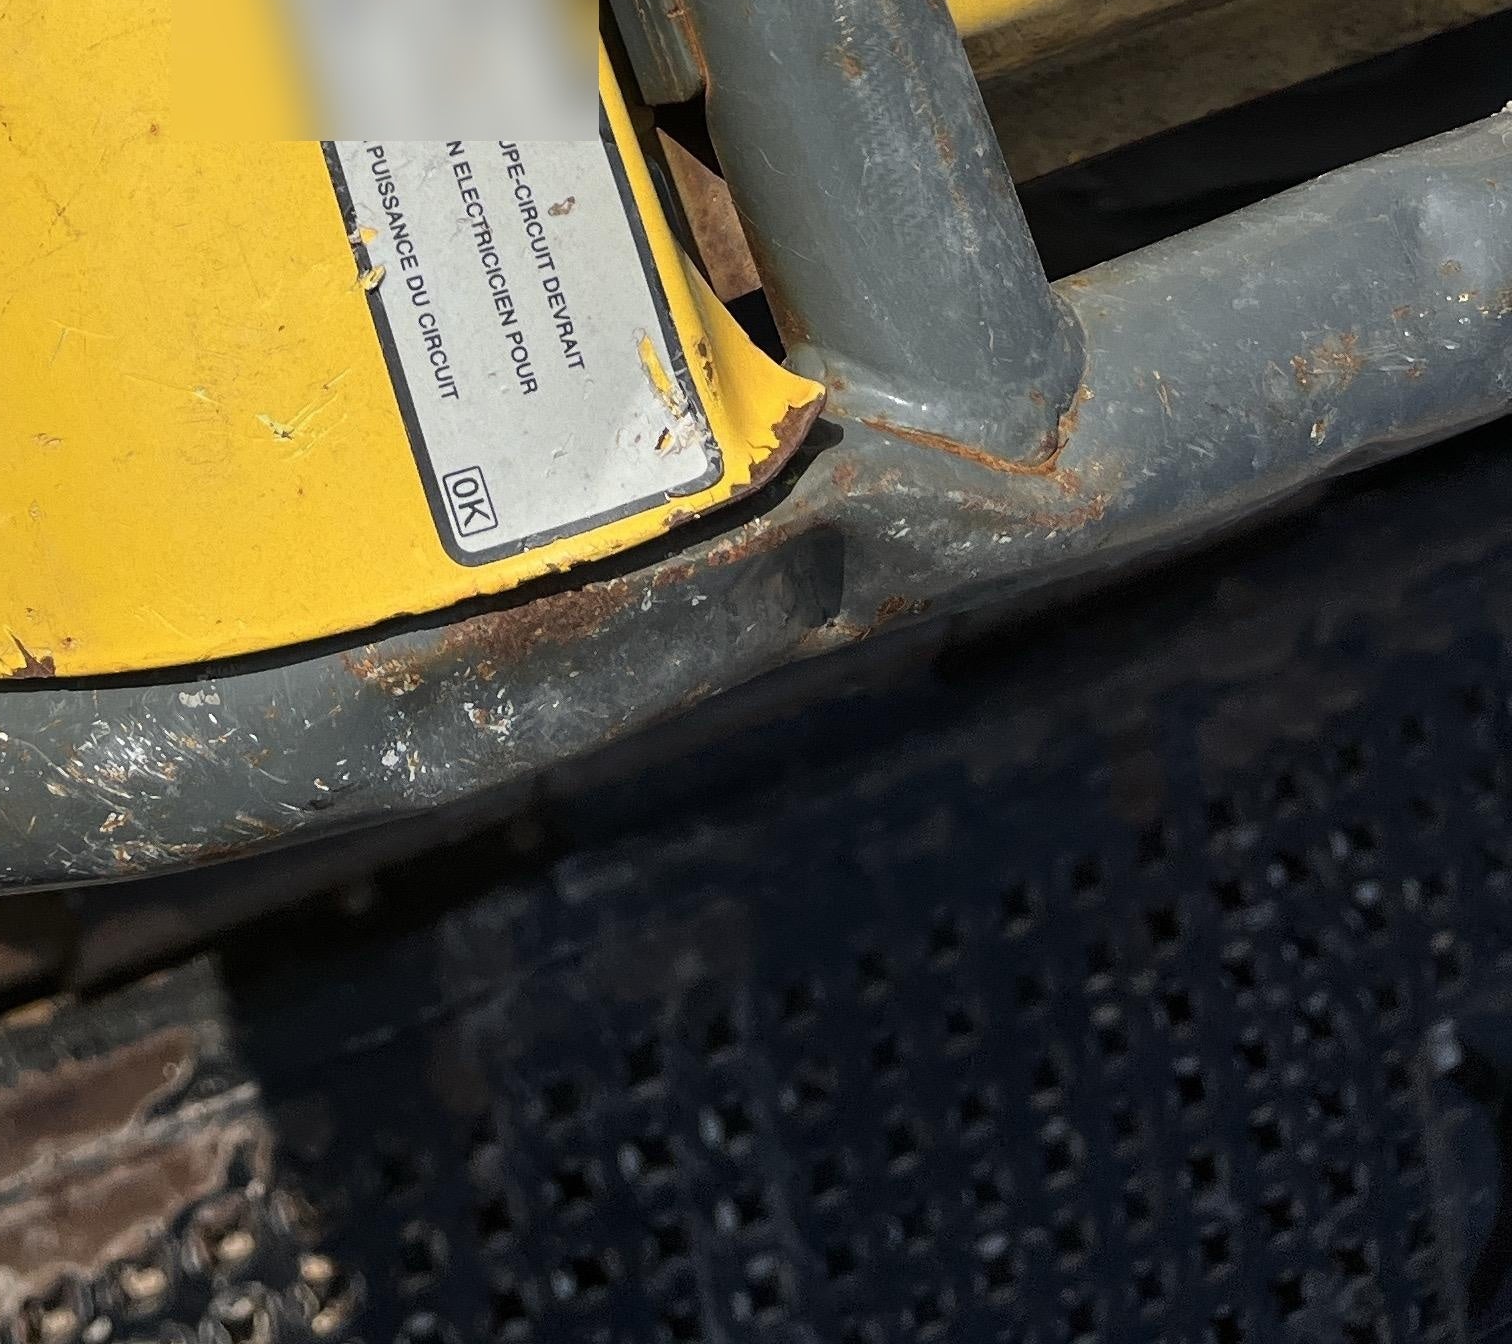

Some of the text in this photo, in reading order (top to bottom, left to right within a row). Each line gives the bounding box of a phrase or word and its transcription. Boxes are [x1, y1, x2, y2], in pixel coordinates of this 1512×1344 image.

[365, 144, 460, 403] PUISSANCE DU CIRCUIT
[451, 160, 540, 395] ELECTRICICIEN POUR
[541, 275, 586, 373] DEVRAIT
